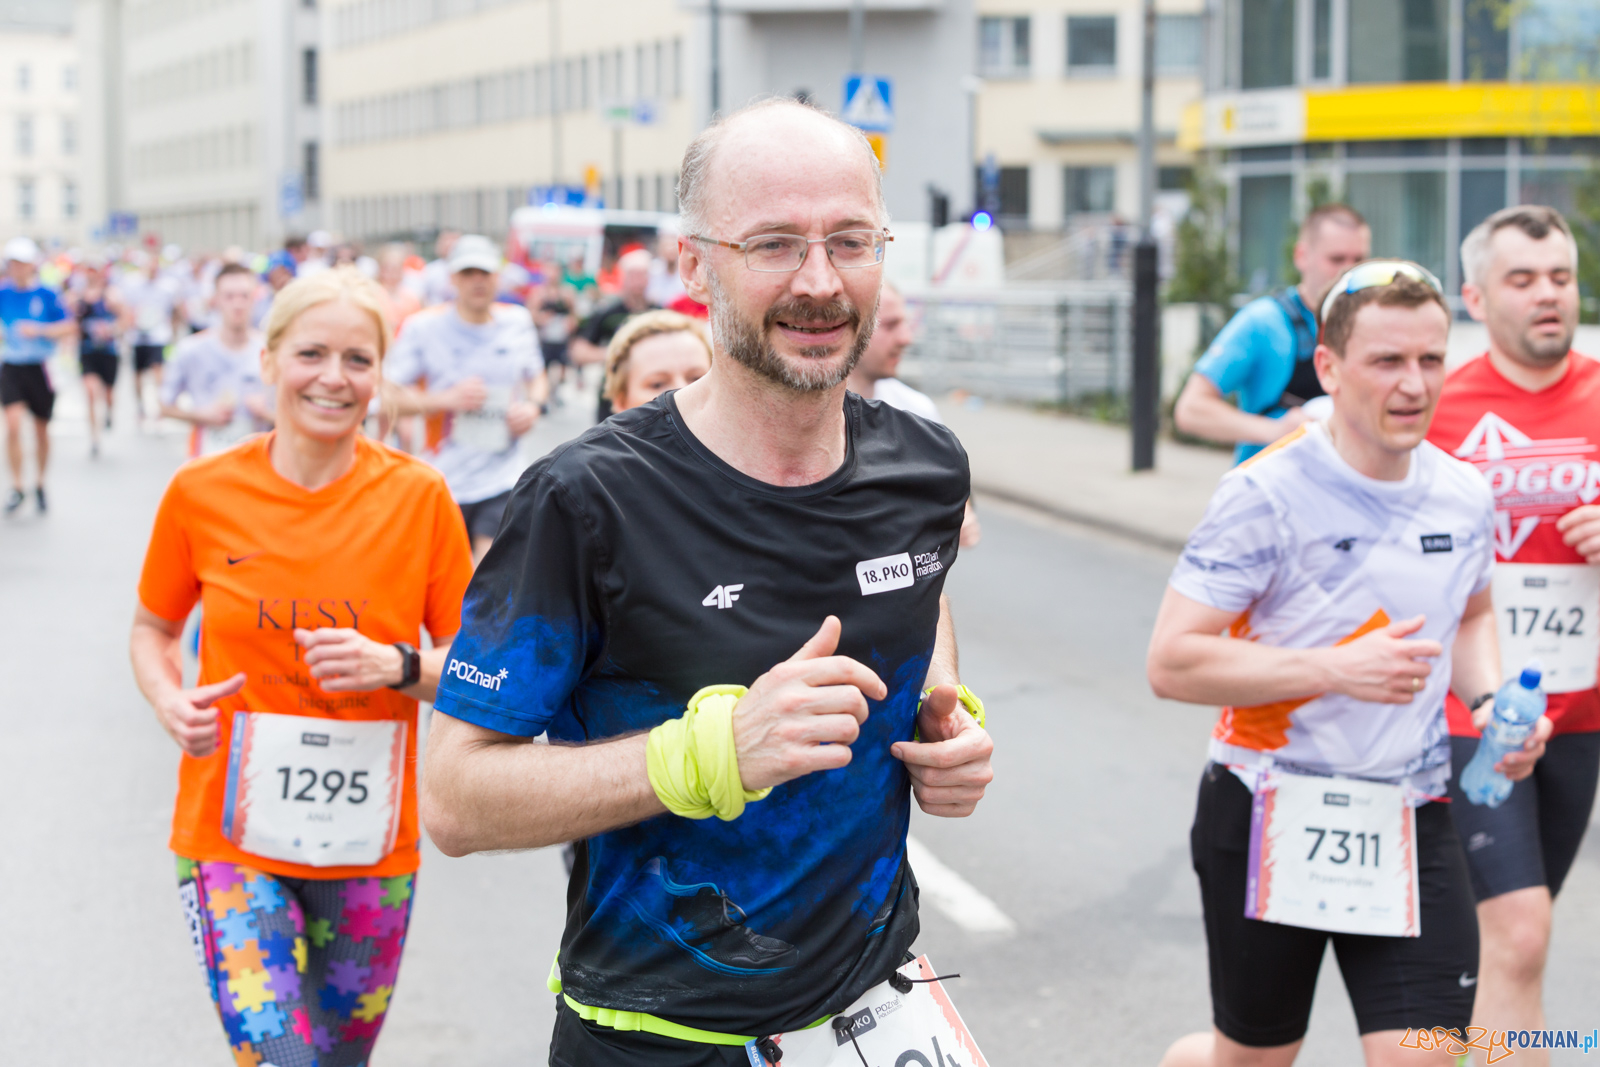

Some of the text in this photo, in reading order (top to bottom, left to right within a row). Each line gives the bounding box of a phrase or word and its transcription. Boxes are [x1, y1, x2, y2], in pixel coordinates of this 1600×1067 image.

[916, 561, 943, 577] maraton
[702, 583, 744, 609] 4F
[258, 599, 369, 630] KESY
[1506, 607, 1585, 636] 1742
[277, 767, 368, 804] 1295
[1305, 827, 1380, 867] 7311
